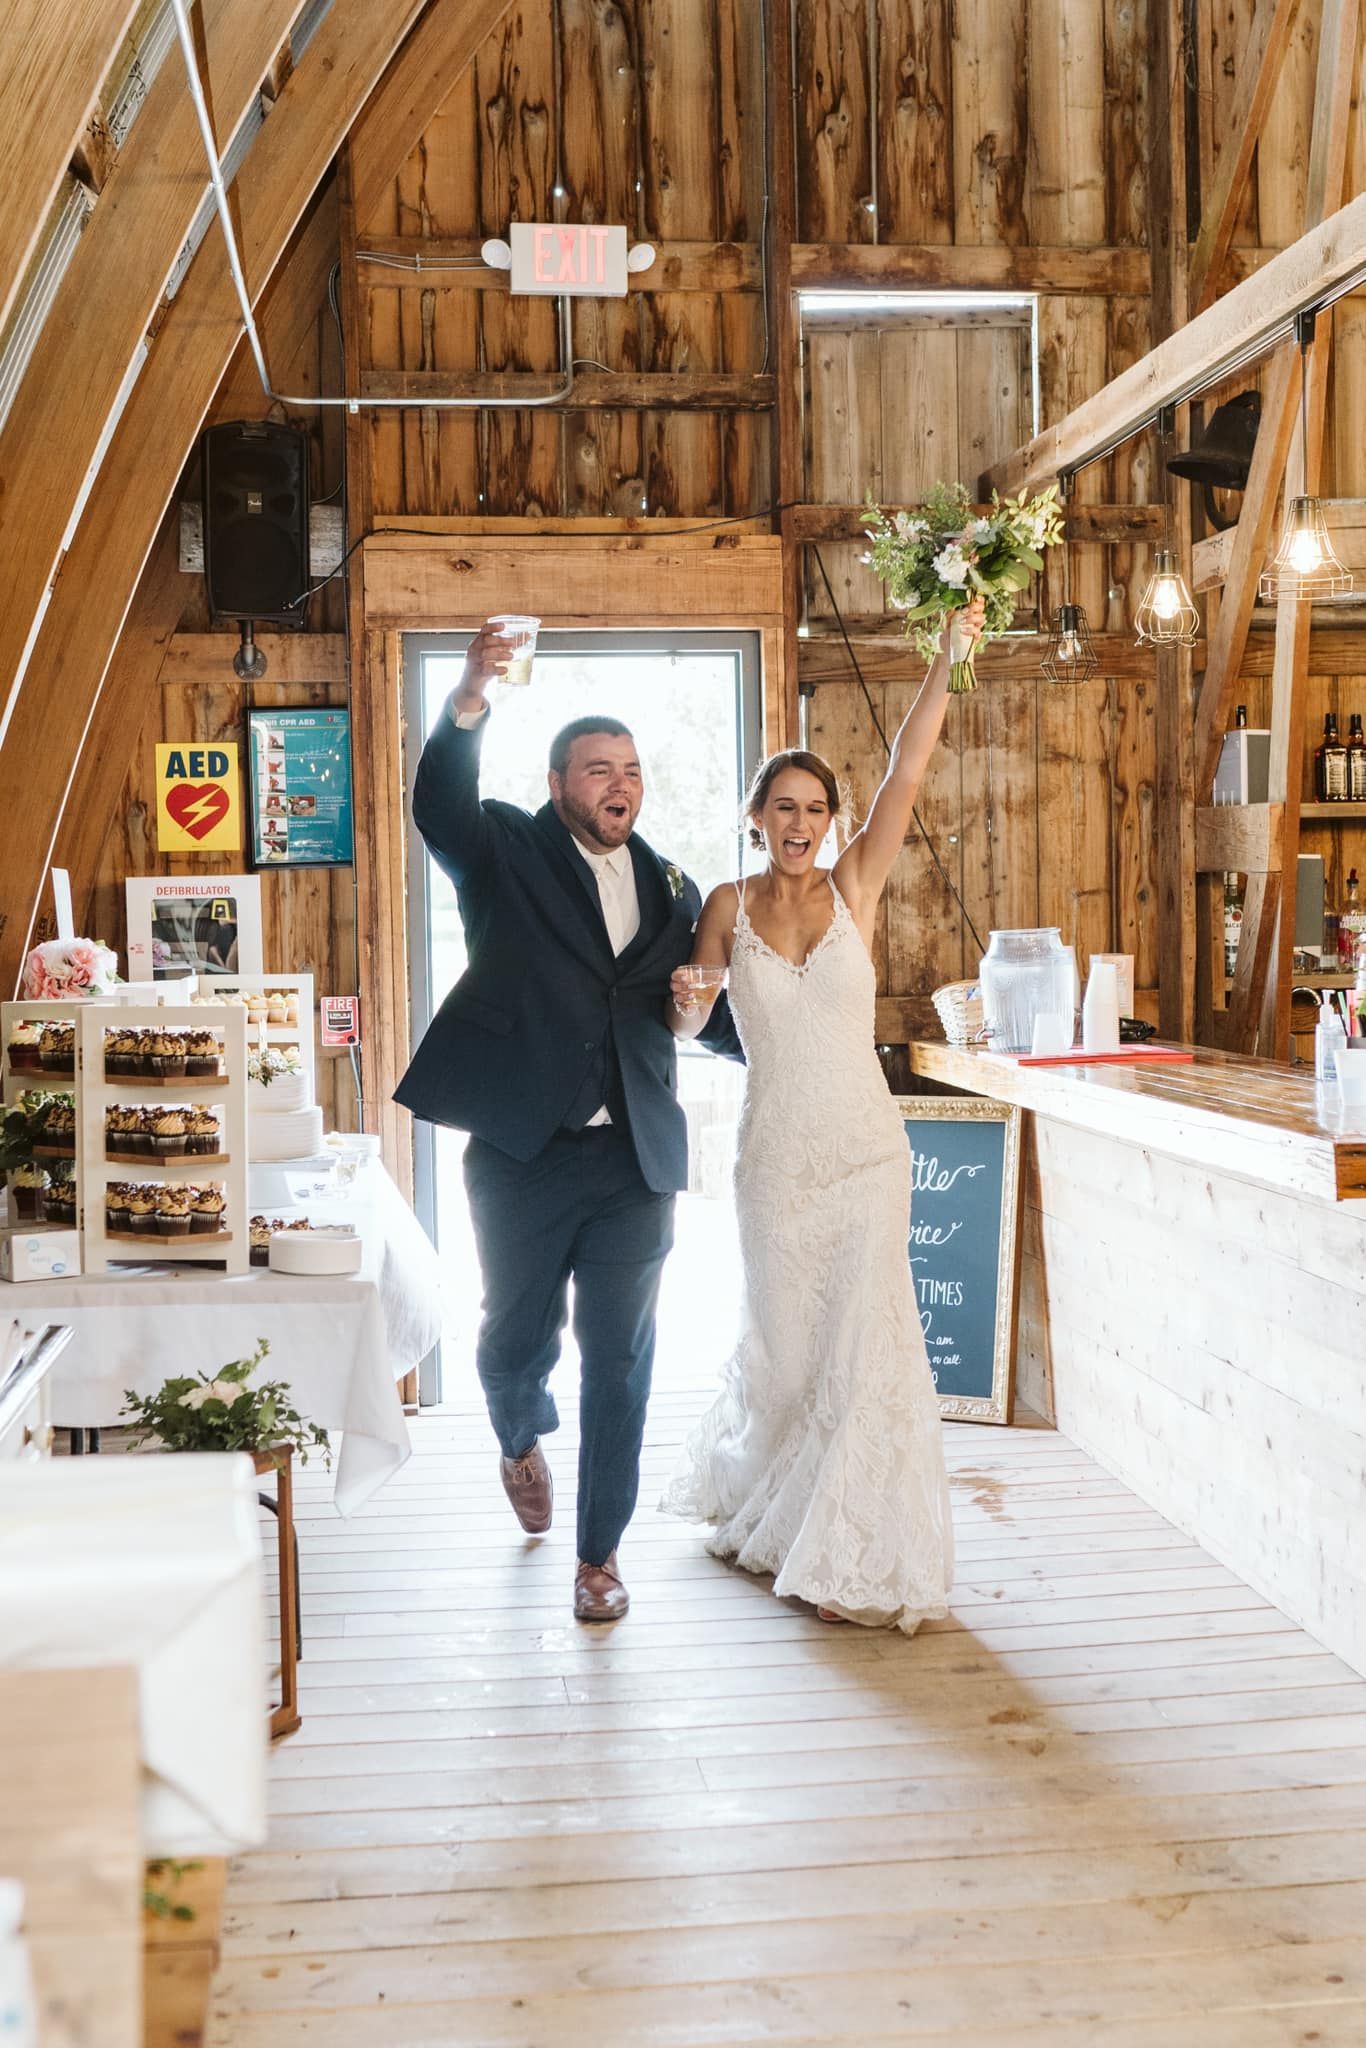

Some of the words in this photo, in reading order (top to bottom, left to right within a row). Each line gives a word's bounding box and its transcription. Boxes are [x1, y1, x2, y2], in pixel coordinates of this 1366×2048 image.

[533, 227, 609, 283] EXIT
[298, 718, 316, 726] AED
[165, 751, 230, 779] AED
[156, 886, 231, 896] DEFIBRILLATOR
[325, 999, 353, 1010] FIRE
[917, 1278, 963, 1306] TIMES
